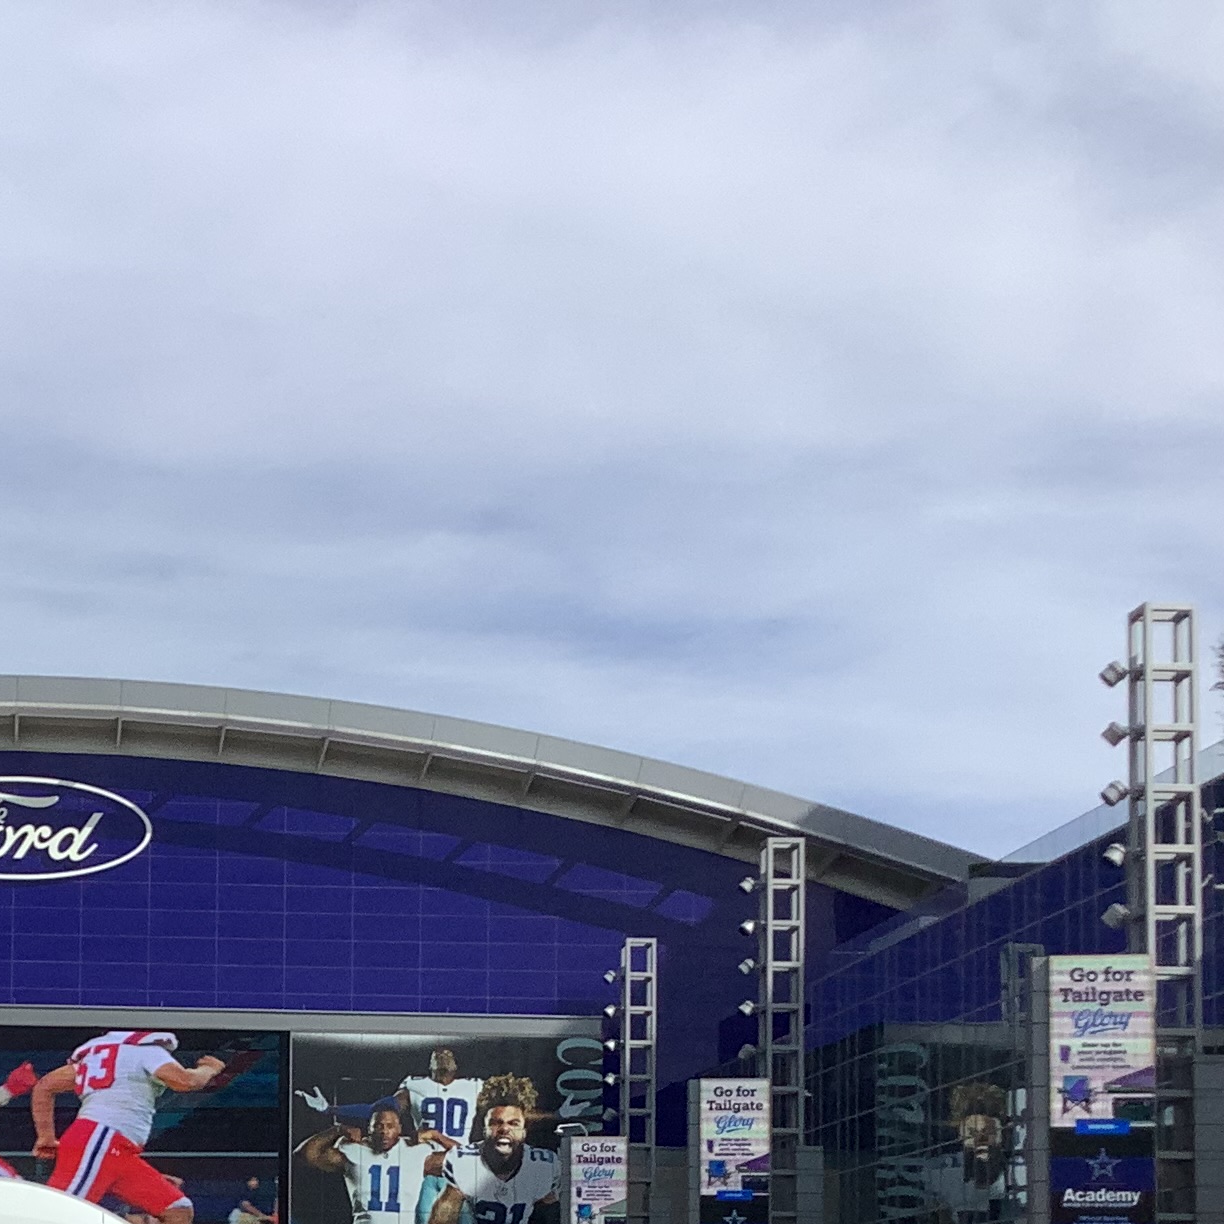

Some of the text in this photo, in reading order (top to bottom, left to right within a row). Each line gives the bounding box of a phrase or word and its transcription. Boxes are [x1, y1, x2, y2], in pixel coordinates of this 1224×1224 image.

[1069, 965, 1135, 982] Go for
[1059, 986, 1145, 1006] Tailgate
[1071, 1008, 1133, 1038] Glory
[713, 1085, 757, 1098] Go for
[707, 1100, 764, 1113] Tailgate
[421, 1097, 468, 1137] 90
[714, 1114, 755, 1135] Glory
[581, 1142, 617, 1153] Go for
[576, 1154, 623, 1165] Tailgate
[582, 1167, 615, 1182] Glory
[368, 1165, 401, 1213] 11
[1062, 1187, 1142, 1206] Academy
